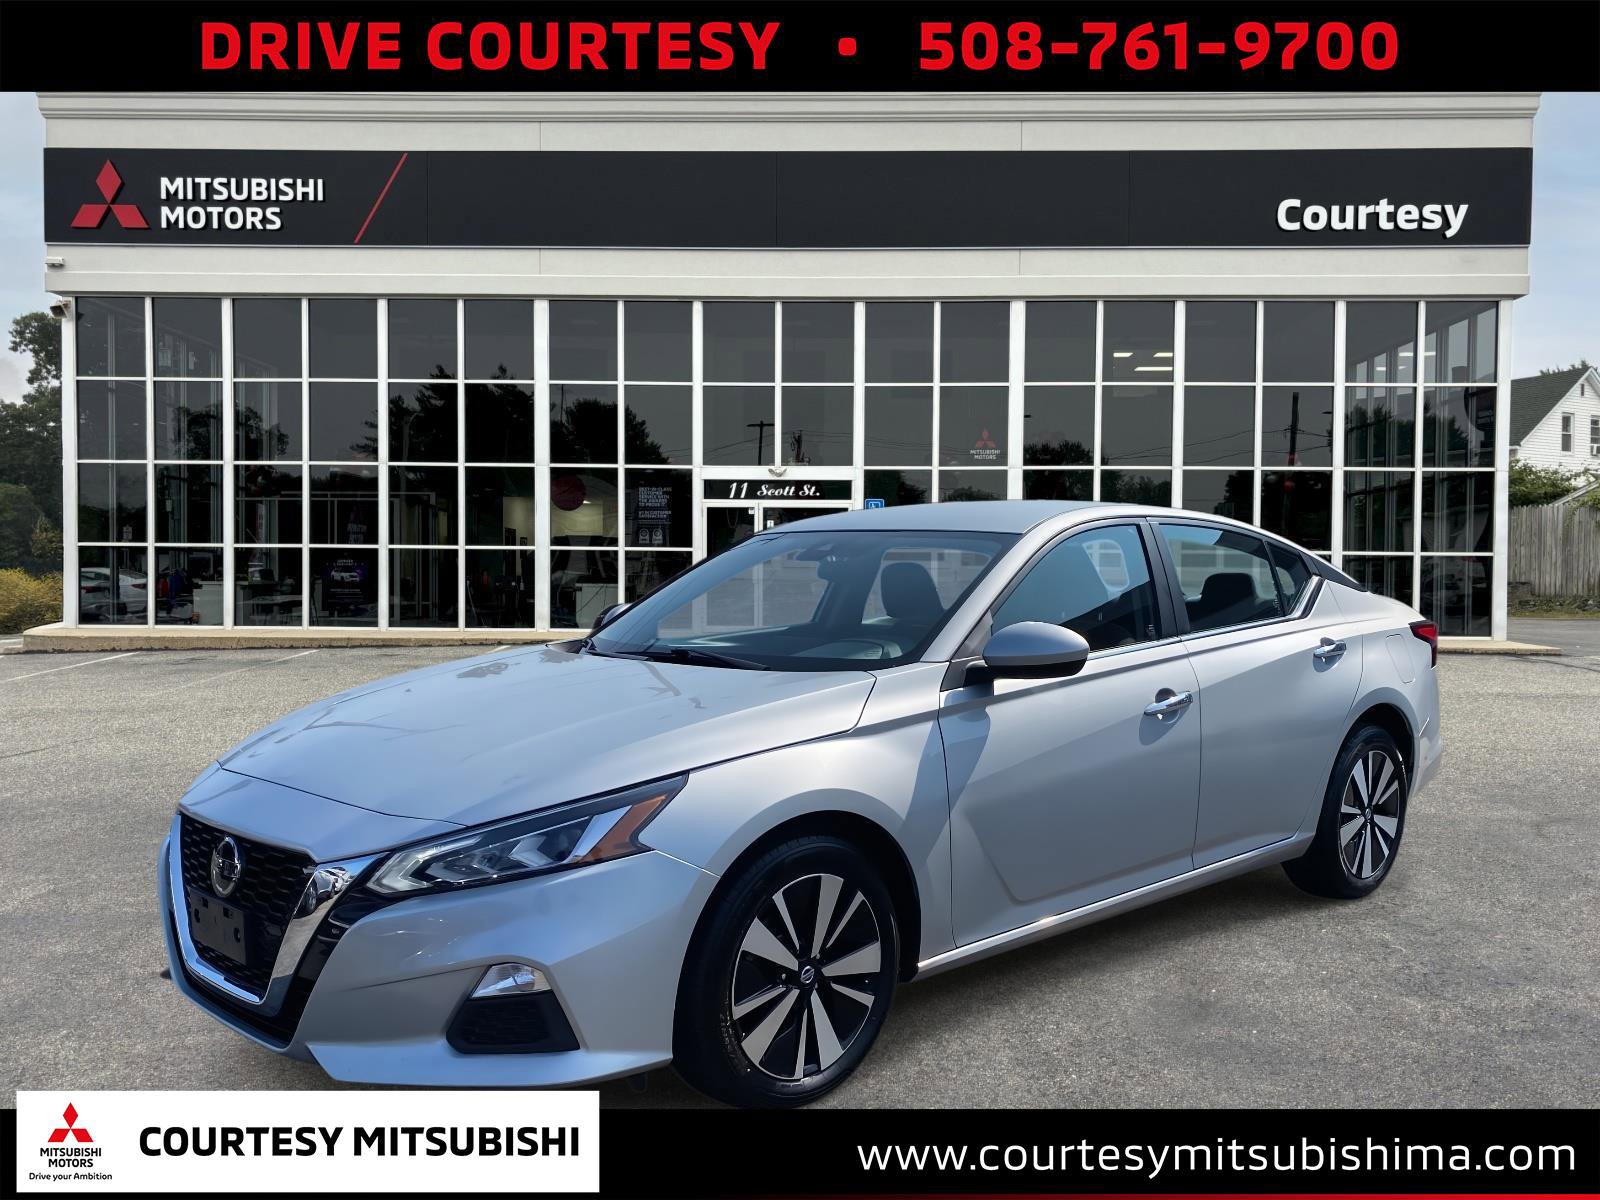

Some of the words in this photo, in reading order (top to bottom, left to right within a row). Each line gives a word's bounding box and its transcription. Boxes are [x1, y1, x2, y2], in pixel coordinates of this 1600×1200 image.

[160, 176, 325, 201] MITSUBISHI
[160, 206, 282, 230] MOTORS
[1277, 198, 1469, 239] Courtesy
[729, 482, 748, 499] 11
[757, 484, 796, 496] Scott
[799, 484, 820, 496] St.
